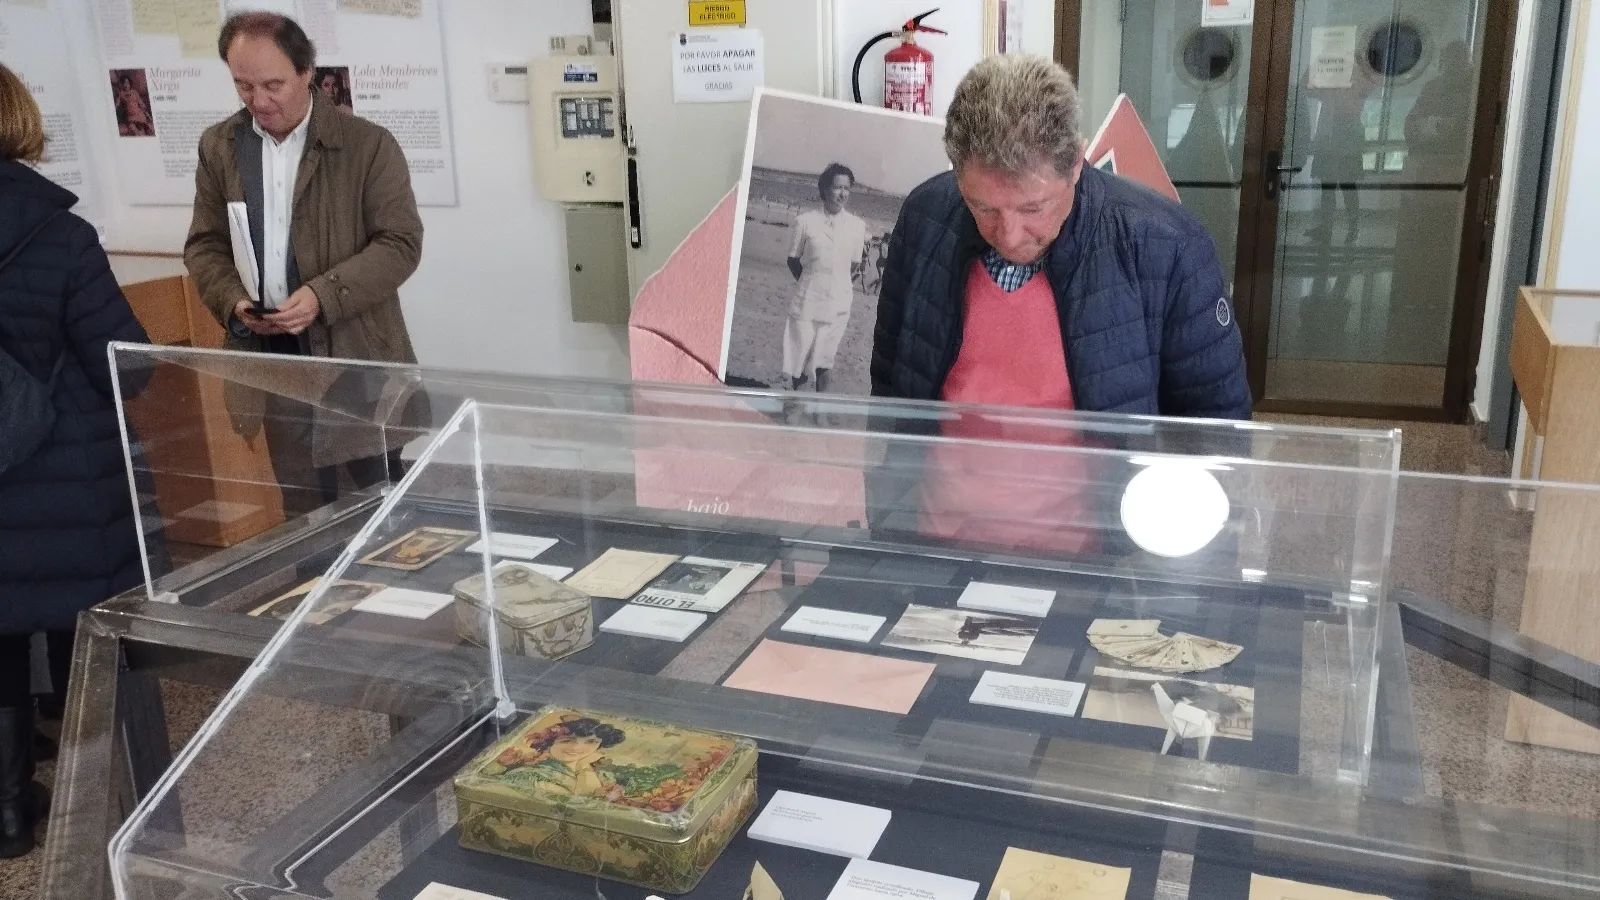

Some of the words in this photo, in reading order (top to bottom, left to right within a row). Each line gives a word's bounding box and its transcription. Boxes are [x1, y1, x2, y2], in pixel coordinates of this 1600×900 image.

[680, 51, 695, 60] POR
[697, 50, 721, 60] FAVOR
[723, 48, 756, 58] APAGAR
[149, 66, 201, 81] Margarita
[352, 64, 376, 77] Lola
[380, 64, 438, 77] Membrives
[683, 64, 696, 73] LAS
[698, 63, 721, 73] LUCES
[723, 63, 732, 72] AL
[734, 62, 754, 72] SALIR
[704, 82, 733, 91] GRACIAS
[686, 496, 731, 515] bajo
[636, 594, 676, 607] OTRO
[679, 600, 696, 609] EL
